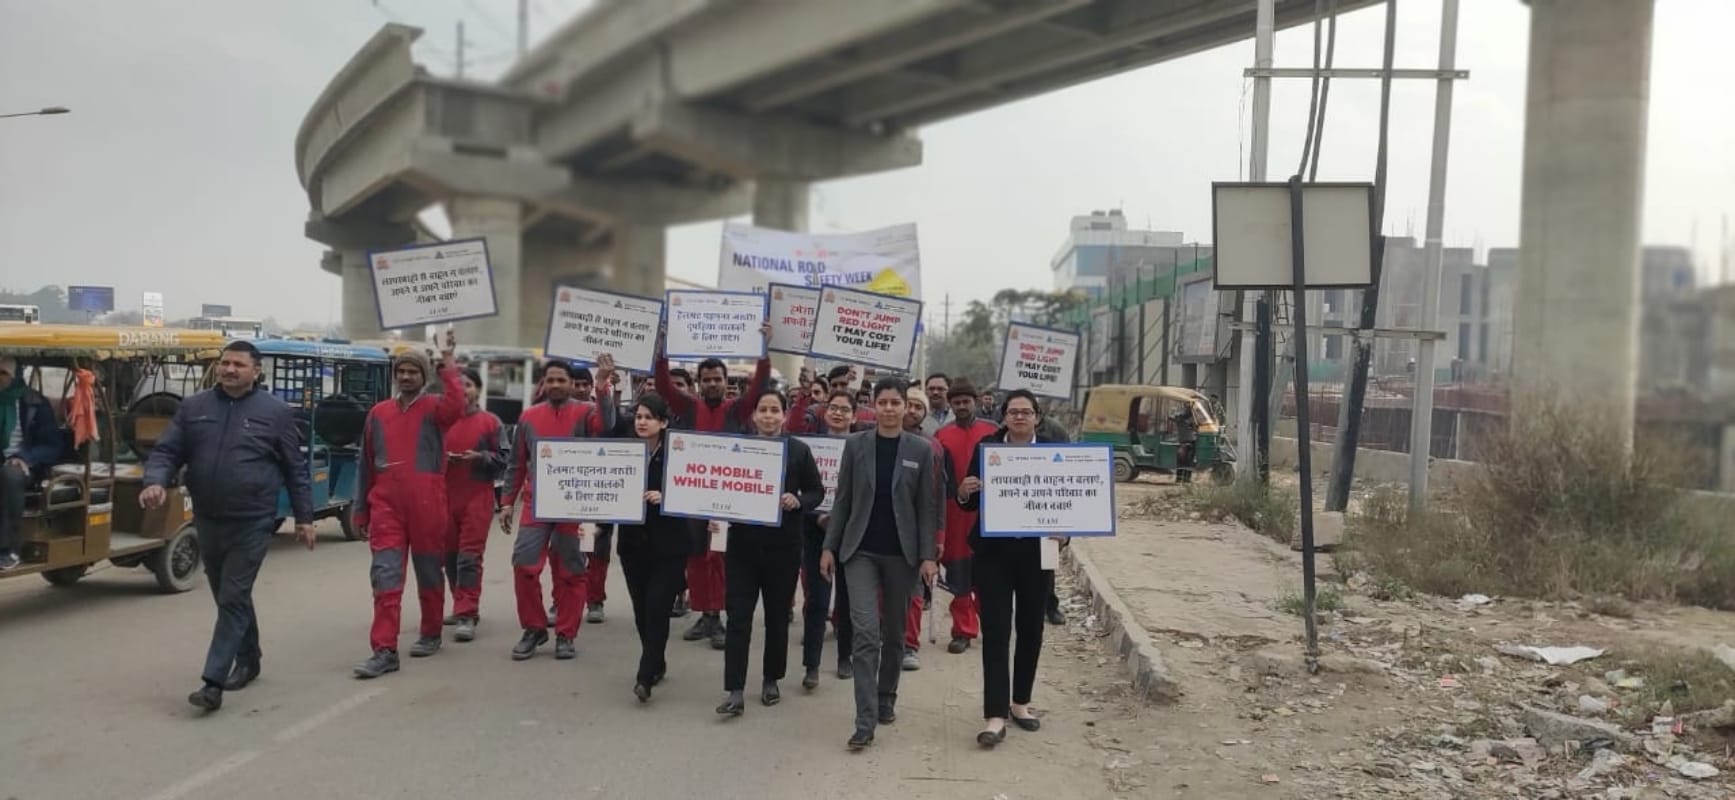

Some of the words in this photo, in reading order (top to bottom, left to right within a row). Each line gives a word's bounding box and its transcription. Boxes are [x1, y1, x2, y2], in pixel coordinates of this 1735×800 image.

[733, 252, 794, 273] NATIONAL
[845, 271, 873, 285] WEEK
[839, 316, 860, 327] RED
[873, 312, 901, 325] JUMP
[118, 332, 180, 347] DABANG
[833, 325, 843, 333] IT
[844, 326, 867, 338] MAY
[868, 330, 897, 343] COST
[835, 334, 864, 346] YOUR
[864, 340, 892, 352] LIFE!
[1021, 352, 1036, 361] RED
[1046, 347, 1065, 357] JUMP
[1016, 360, 1024, 369] IT
[1025, 362, 1041, 371] MAY
[1041, 364, 1062, 374] COST
[1018, 370, 1039, 380] YOUR
[686, 463, 707, 475] NO
[710, 465, 764, 481] MOBILE
[673, 475, 719, 489] WHILE
[721, 480, 775, 495] MOBILE
